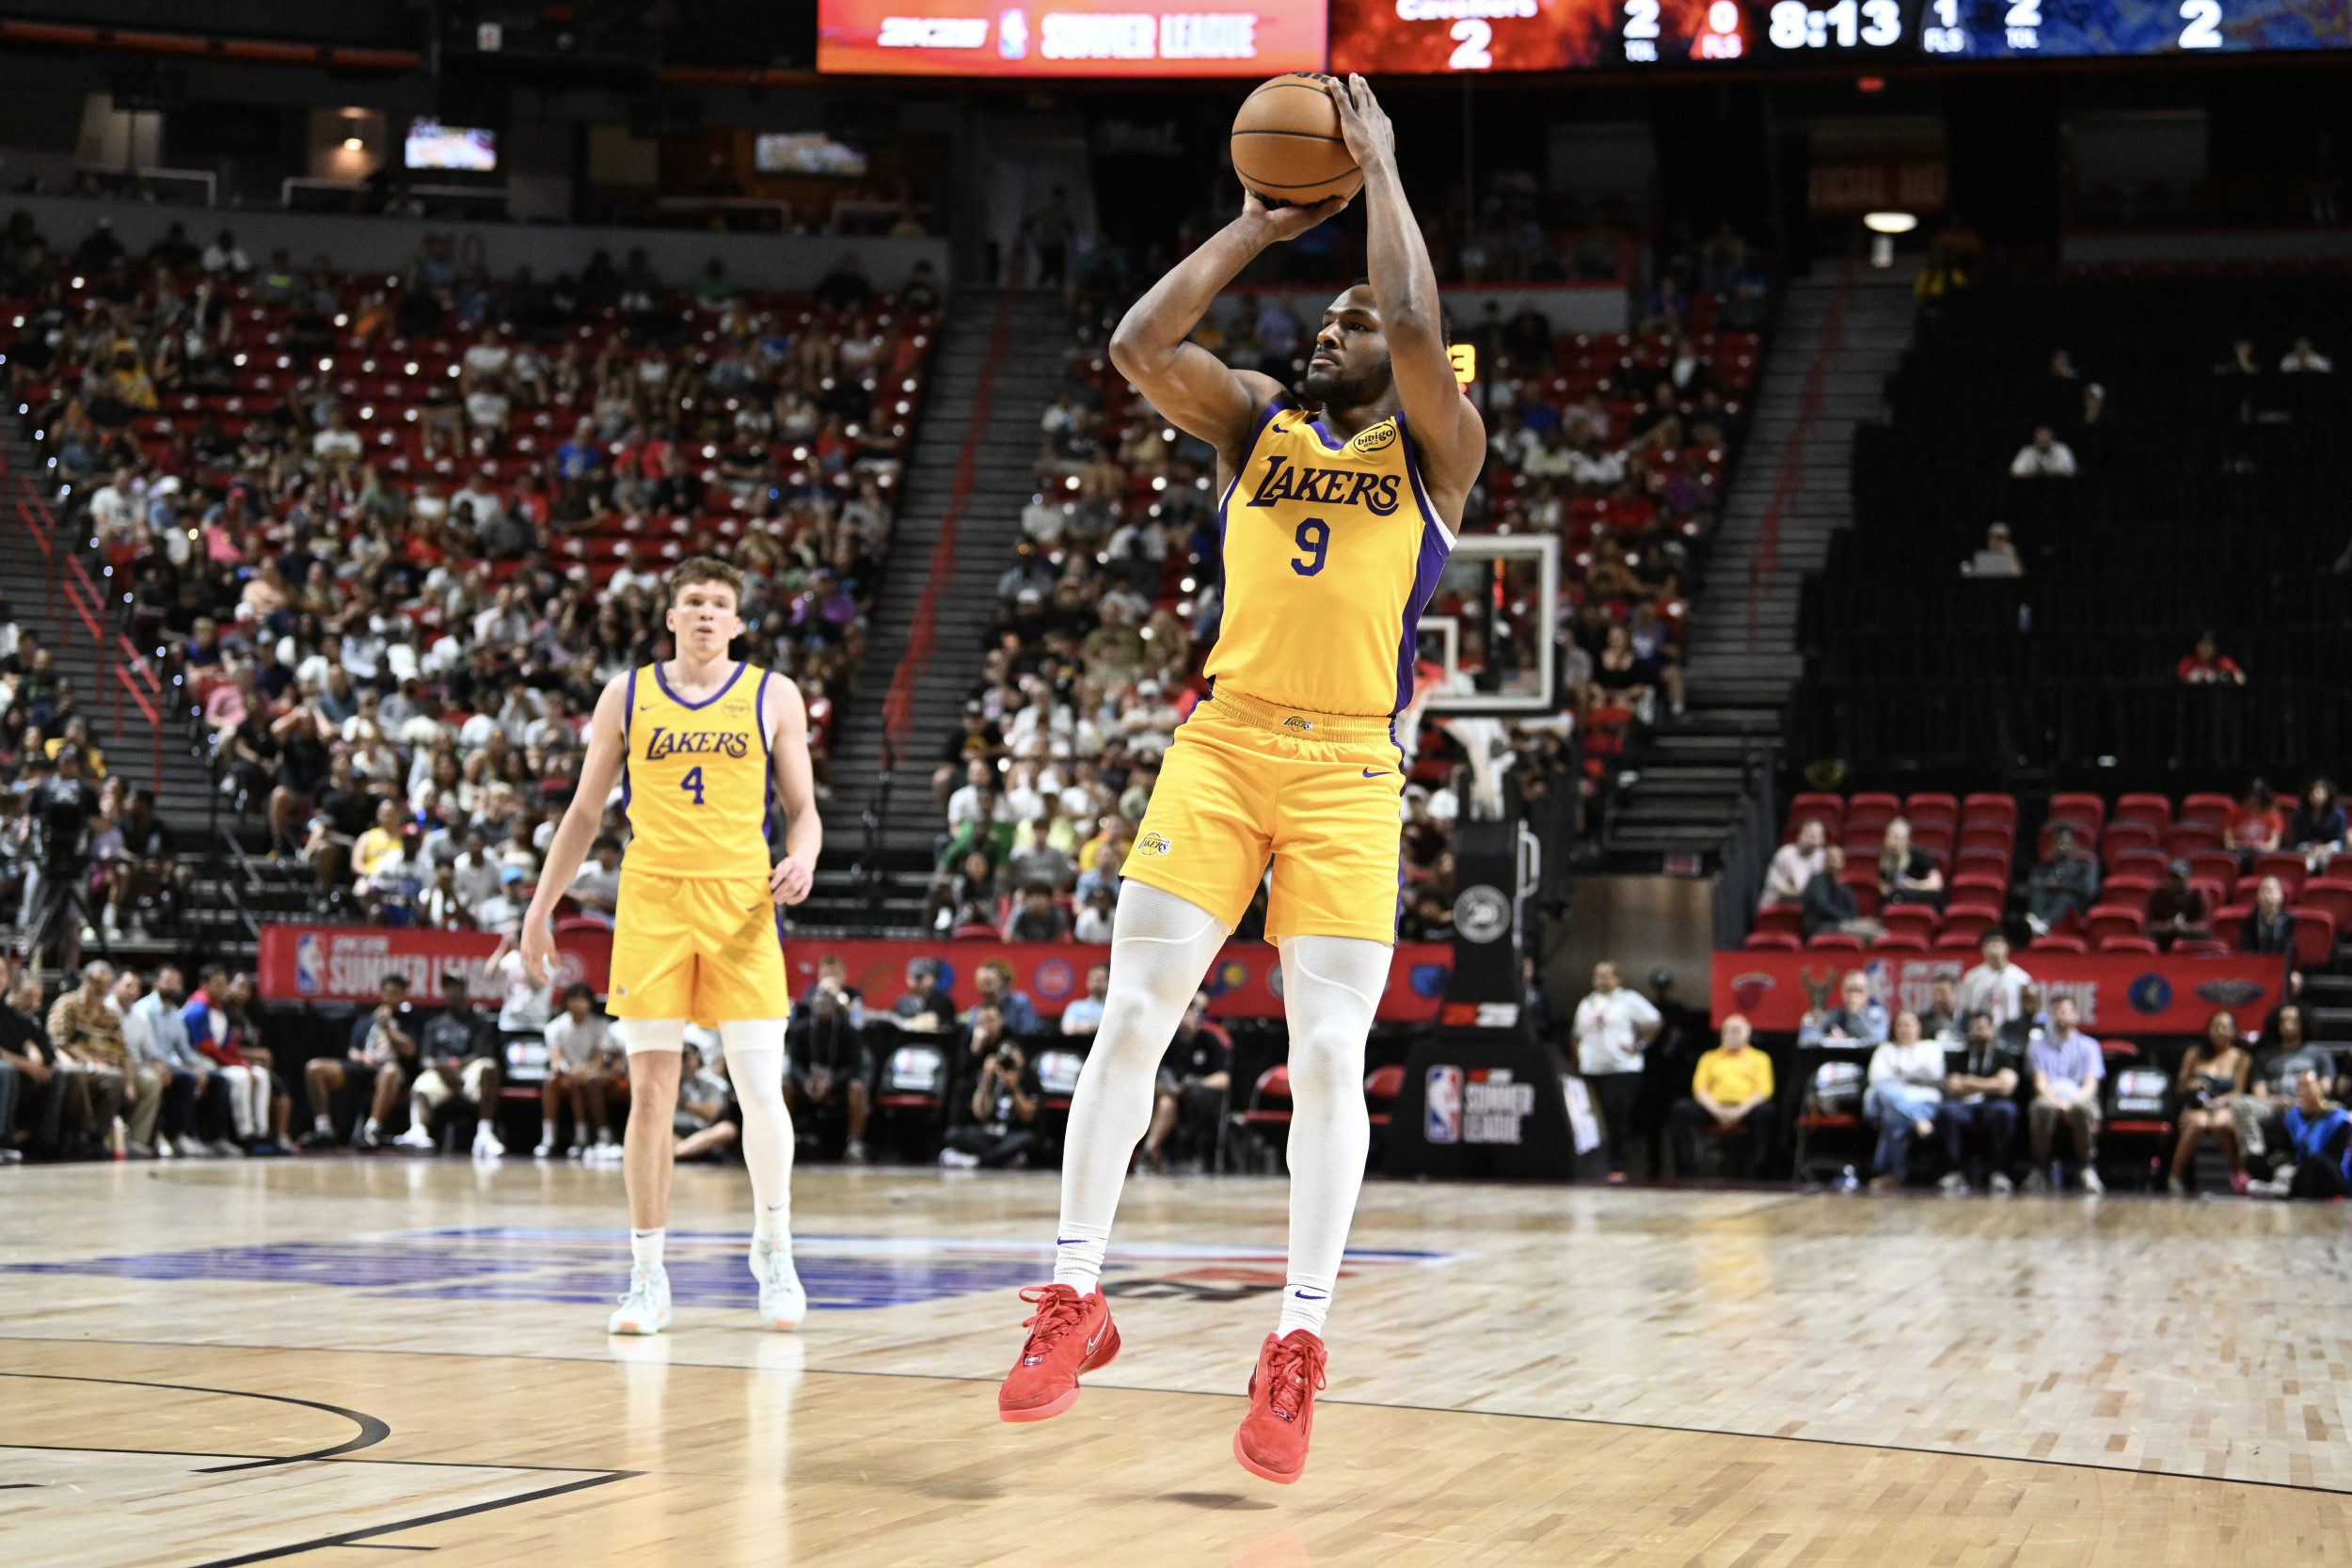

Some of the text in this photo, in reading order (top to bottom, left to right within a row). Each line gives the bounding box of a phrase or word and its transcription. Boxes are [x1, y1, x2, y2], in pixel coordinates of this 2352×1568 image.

[1624, 0, 1660, 38] 2
[1770, 0, 1901, 48] 8:13
[1933, 0, 1958, 28] 1
[2005, 0, 2042, 27] 2
[2178, 0, 2223, 49] 2
[1449, 19, 1493, 70] 2
[1358, 430, 1393, 445] bibigo
[1247, 455, 1402, 516] LAKERS
[1290, 517, 1331, 577] 9
[646, 726, 750, 760] LAKERS
[680, 766, 706, 805] 4
